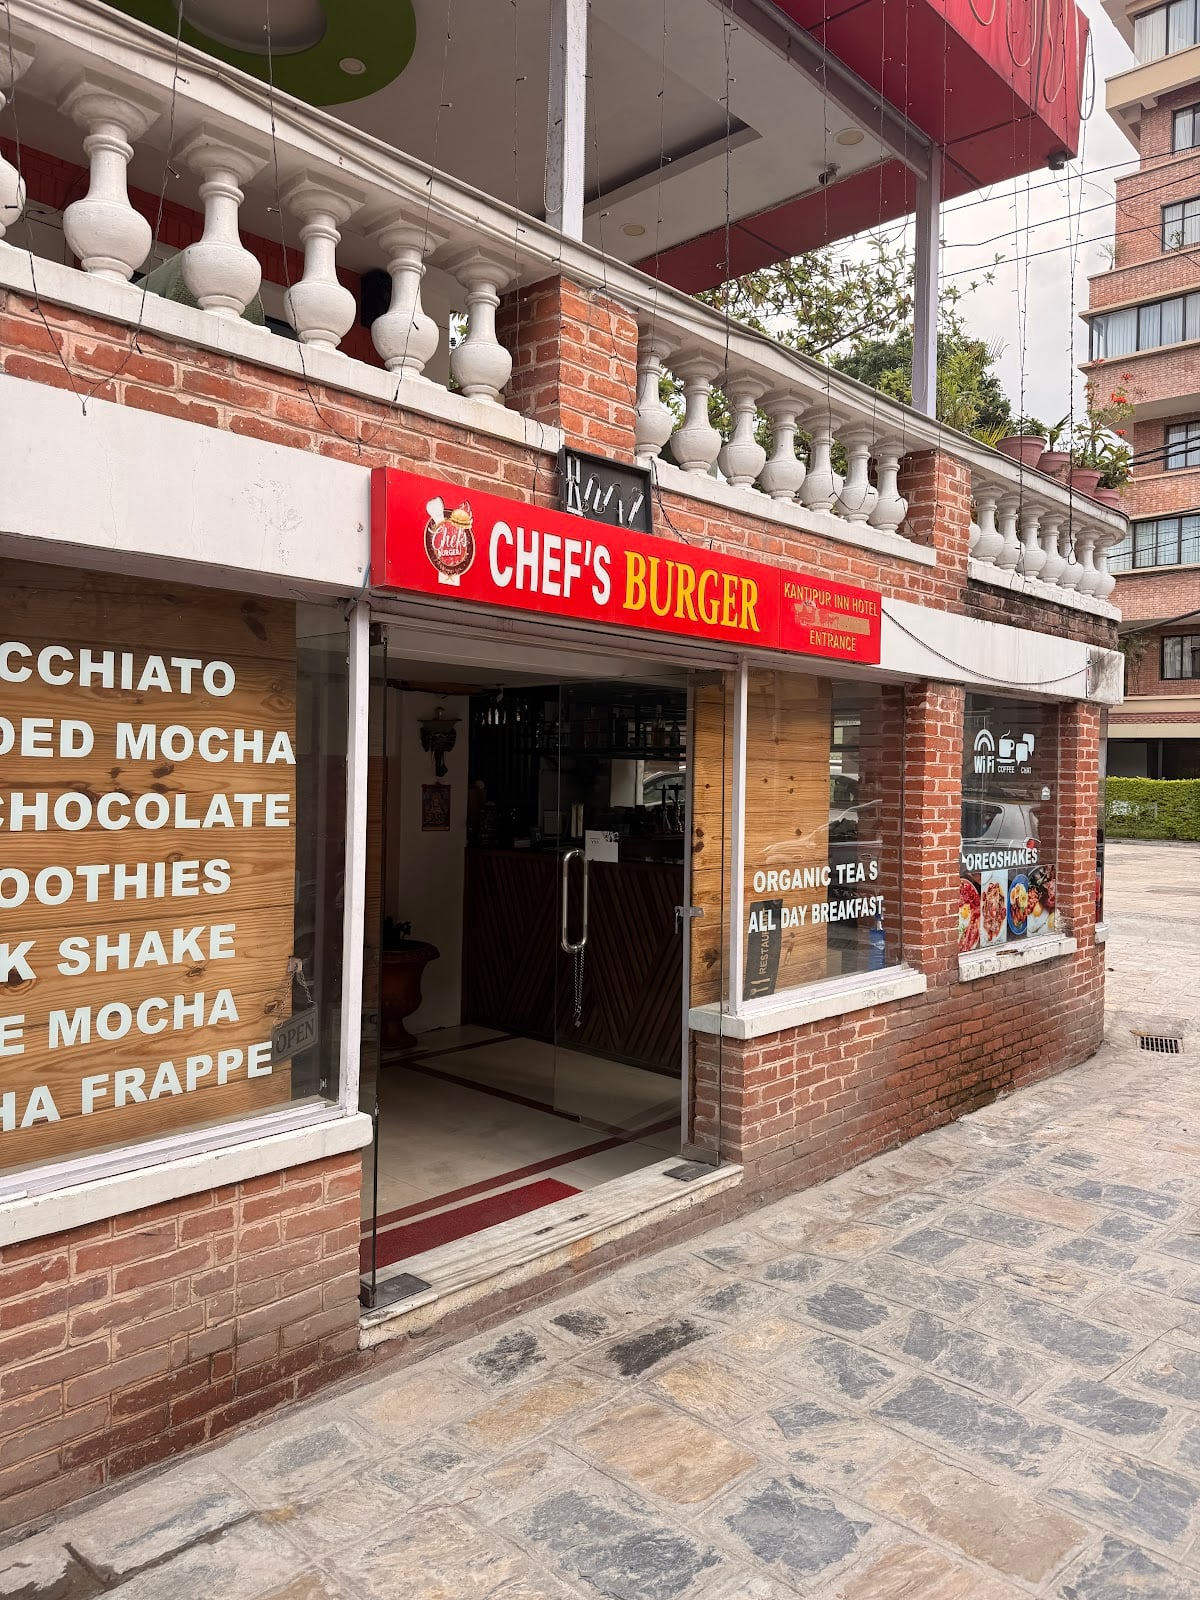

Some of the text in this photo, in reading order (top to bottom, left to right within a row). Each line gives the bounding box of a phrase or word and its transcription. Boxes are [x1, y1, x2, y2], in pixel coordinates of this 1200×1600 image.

[489, 521, 761, 633] CHEF'S BURGER
[784, 582, 878, 617] KANTIPUR INN HOTEL
[809, 629, 857, 652] ENTRANCE
[0, 641, 236, 697] CCHIATO
[115, 722, 297, 765] MOCHA
[974, 755, 995, 774] WiFi
[997, 765, 1015, 774] COFFEE
[0, 792, 290, 832] HOCOLATE
[753, 865, 832, 893] ORGANIC
[966, 847, 1038, 871] OREOSHAKES
[0, 858, 231, 909] OOTHIES
[748, 895, 884, 934] ALL DAY BREAKFAST
[57, 923, 236, 977] SHAKE
[48, 988, 240, 1050] MOCHA
[275, 1019, 315, 1055] OPEN
[81, 1040, 273, 1115] FRAPPE
